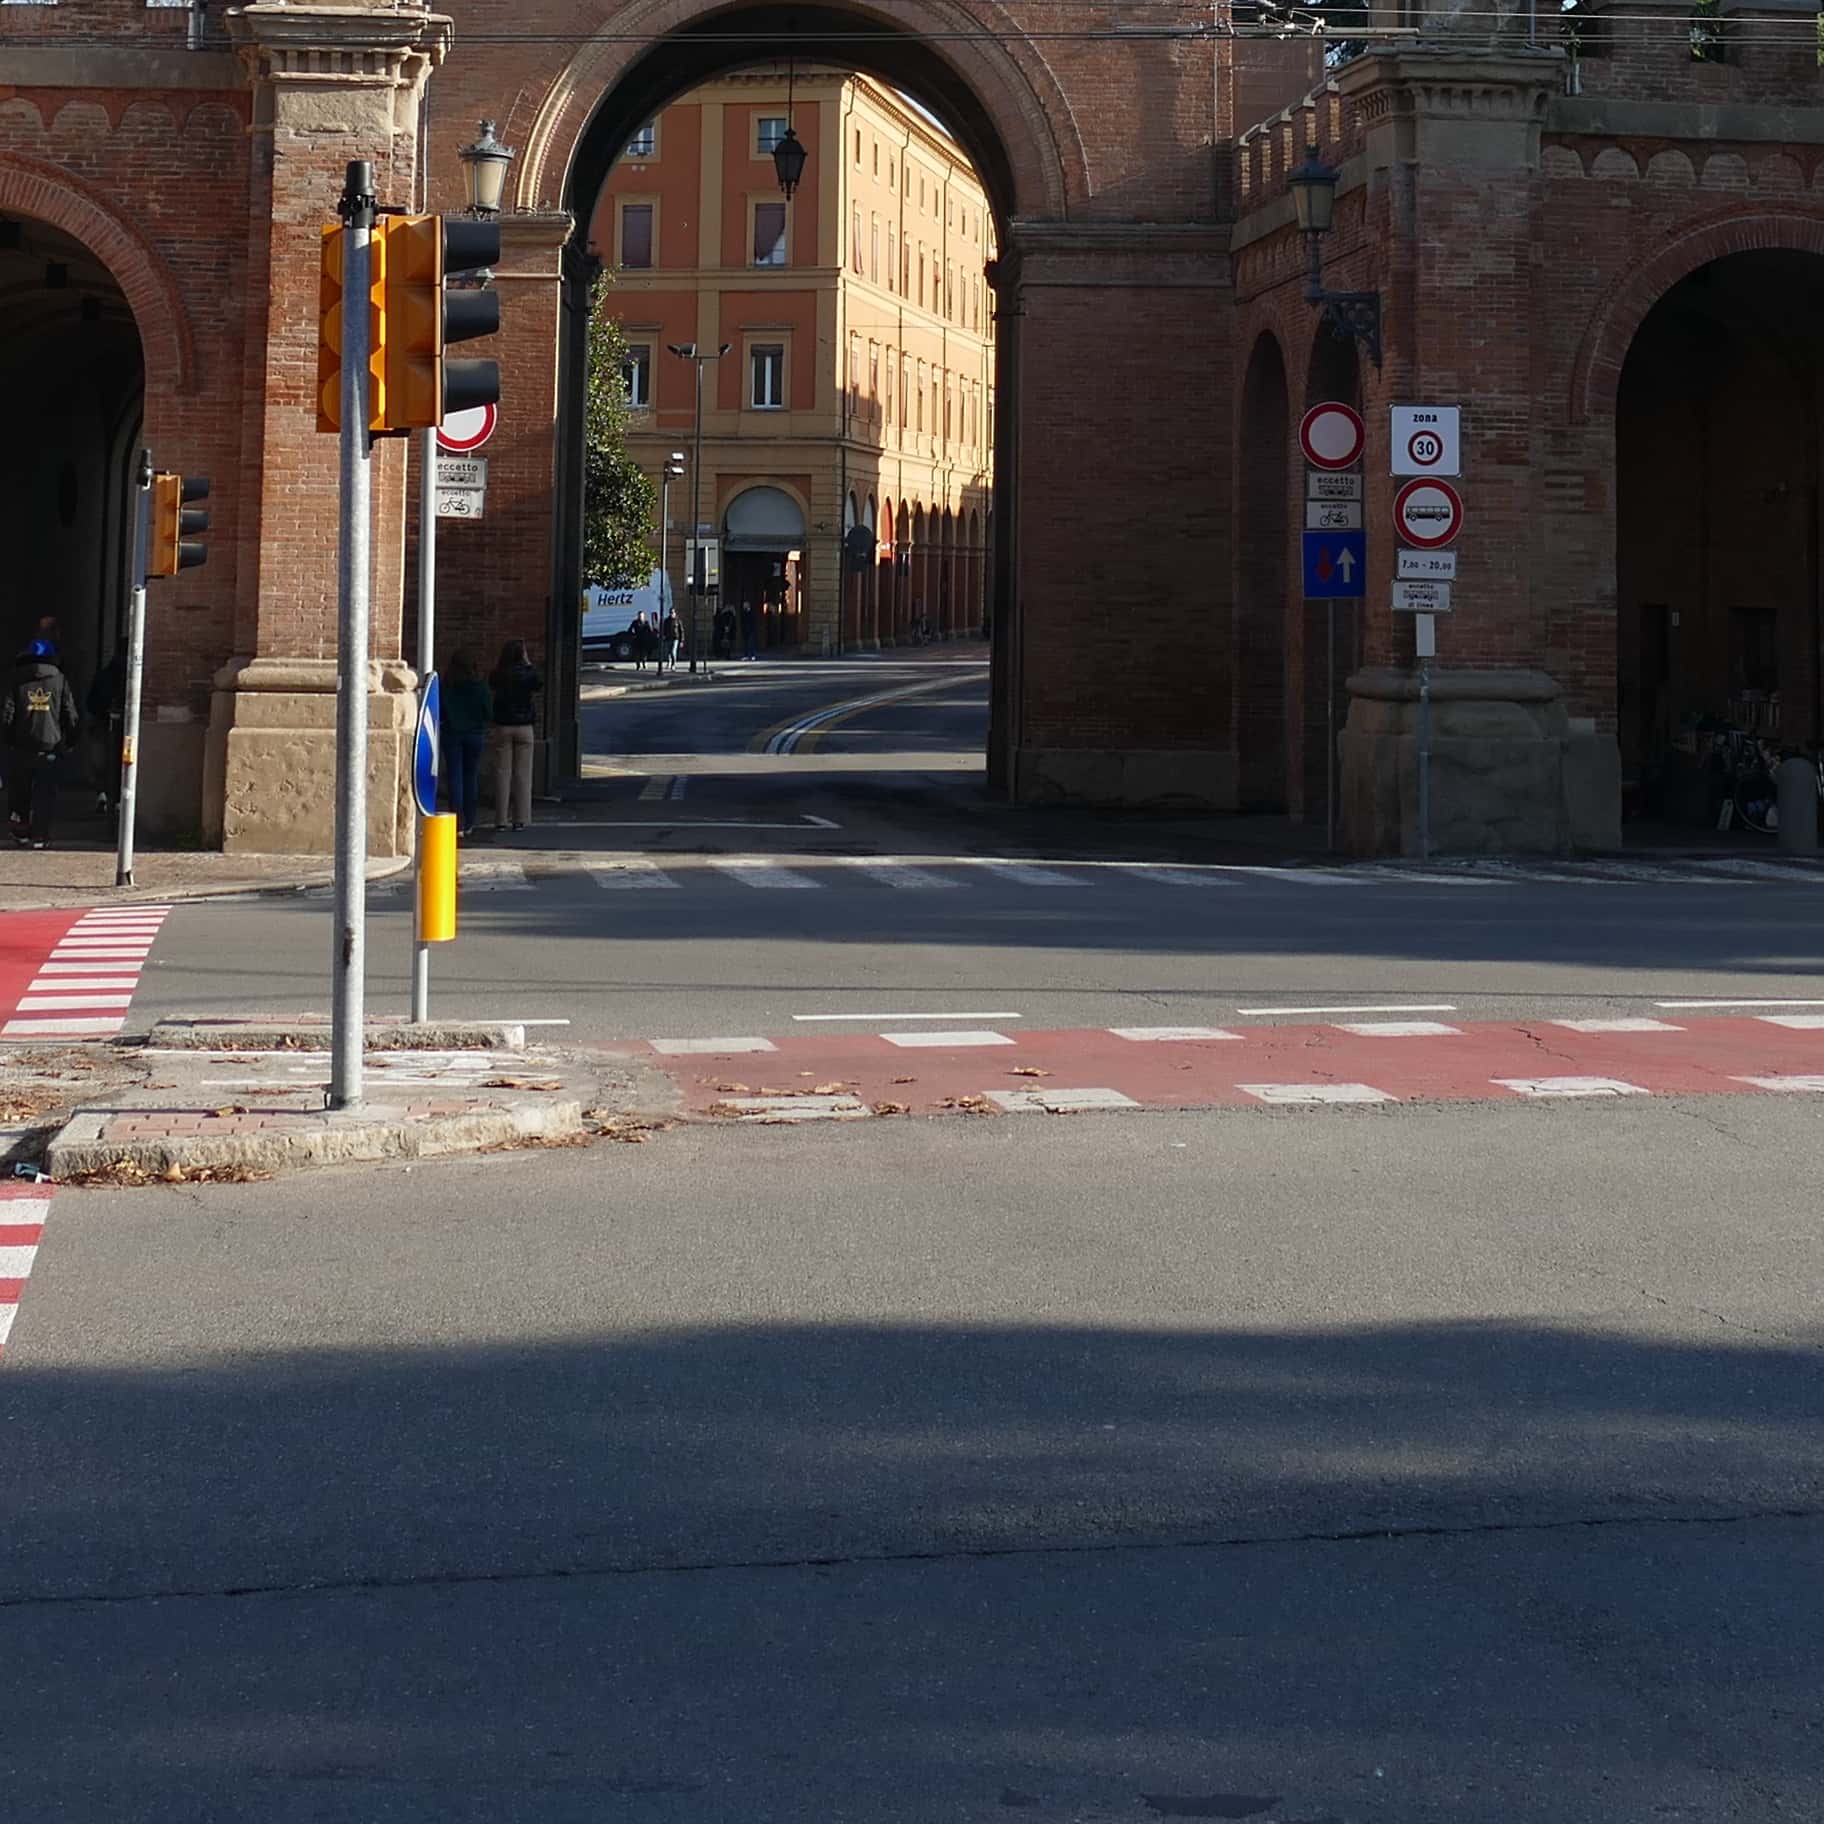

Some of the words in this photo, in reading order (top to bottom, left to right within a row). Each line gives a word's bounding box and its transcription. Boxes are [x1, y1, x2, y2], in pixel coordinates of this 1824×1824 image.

[1413, 413, 1438, 423] zona
[1416, 440, 1435, 456] 30
[437, 463, 479, 473] eccetto
[598, 592, 634, 606] Hertz
